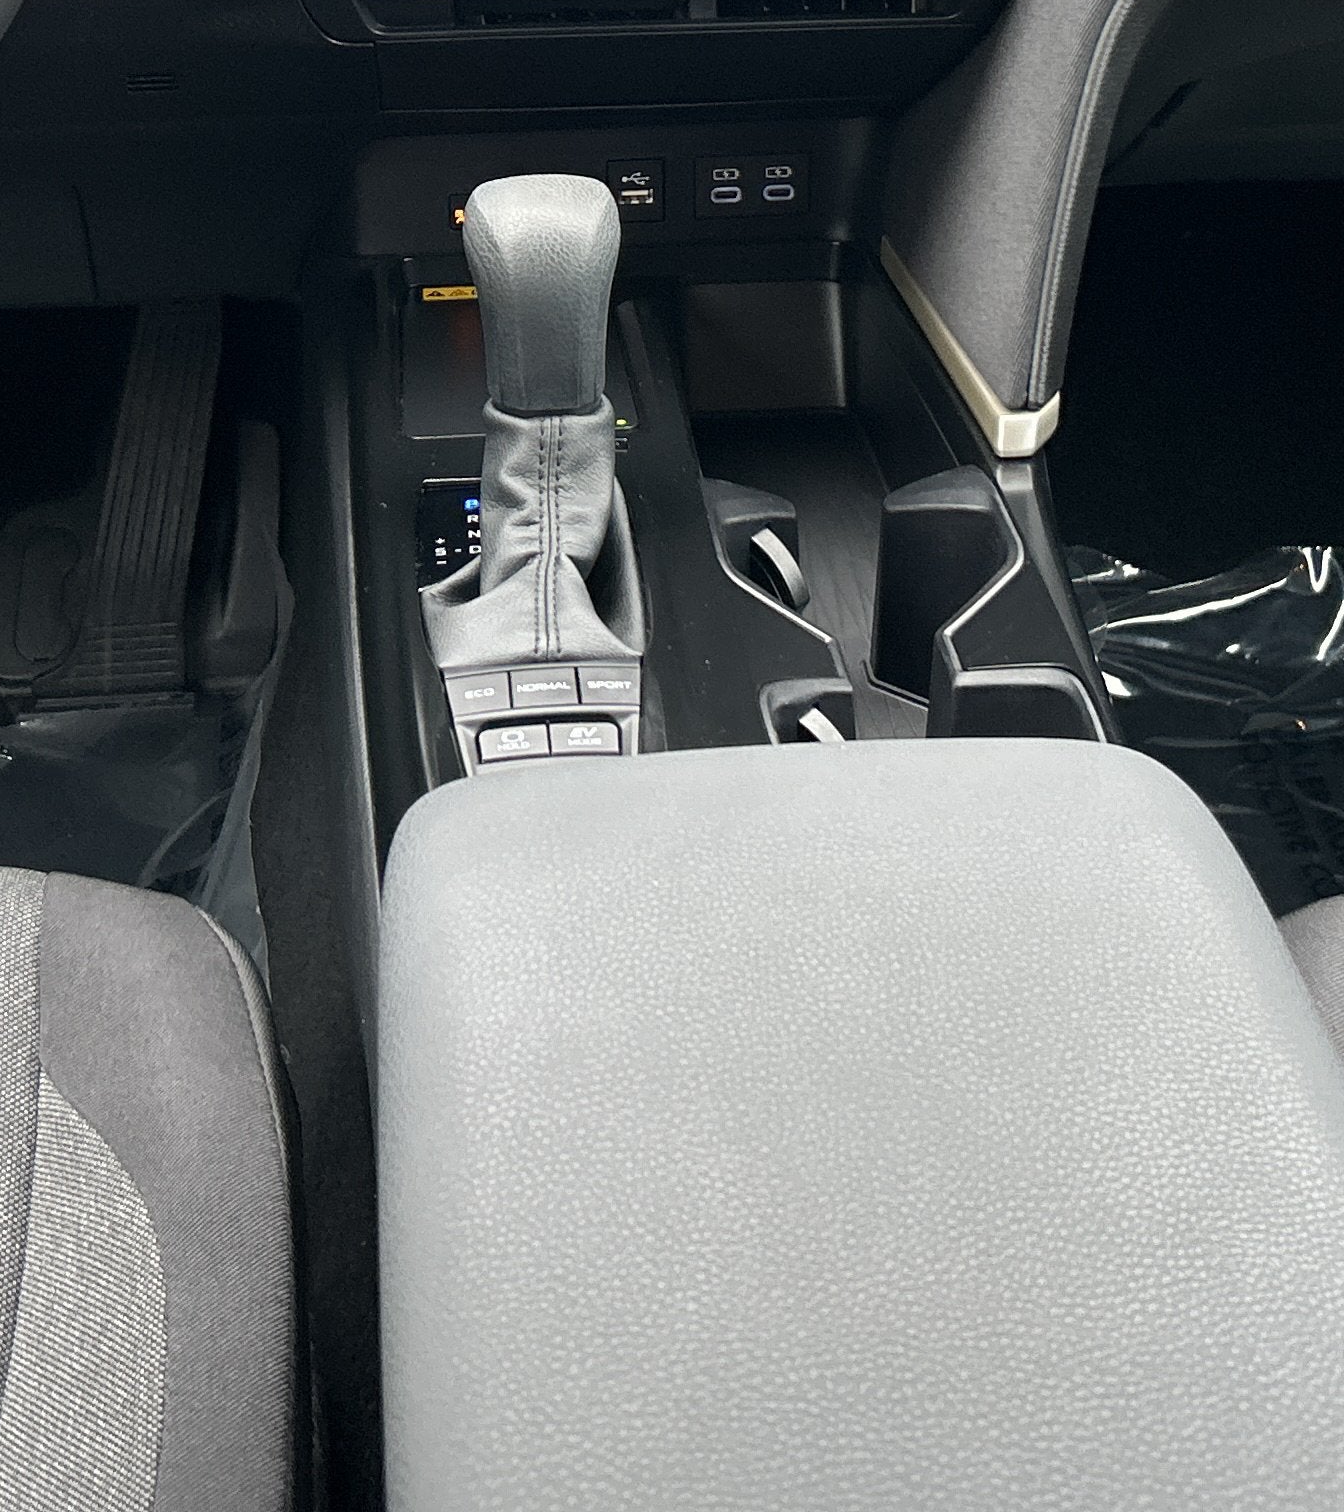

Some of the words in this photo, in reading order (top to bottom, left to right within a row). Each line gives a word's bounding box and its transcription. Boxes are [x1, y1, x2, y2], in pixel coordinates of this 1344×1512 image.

[467, 514, 479, 524] R
[468, 529, 481, 539] N
[516, 681, 572, 694] NORMAL
[587, 680, 632, 690] SPORT
[497, 741, 531, 752] HOLD
